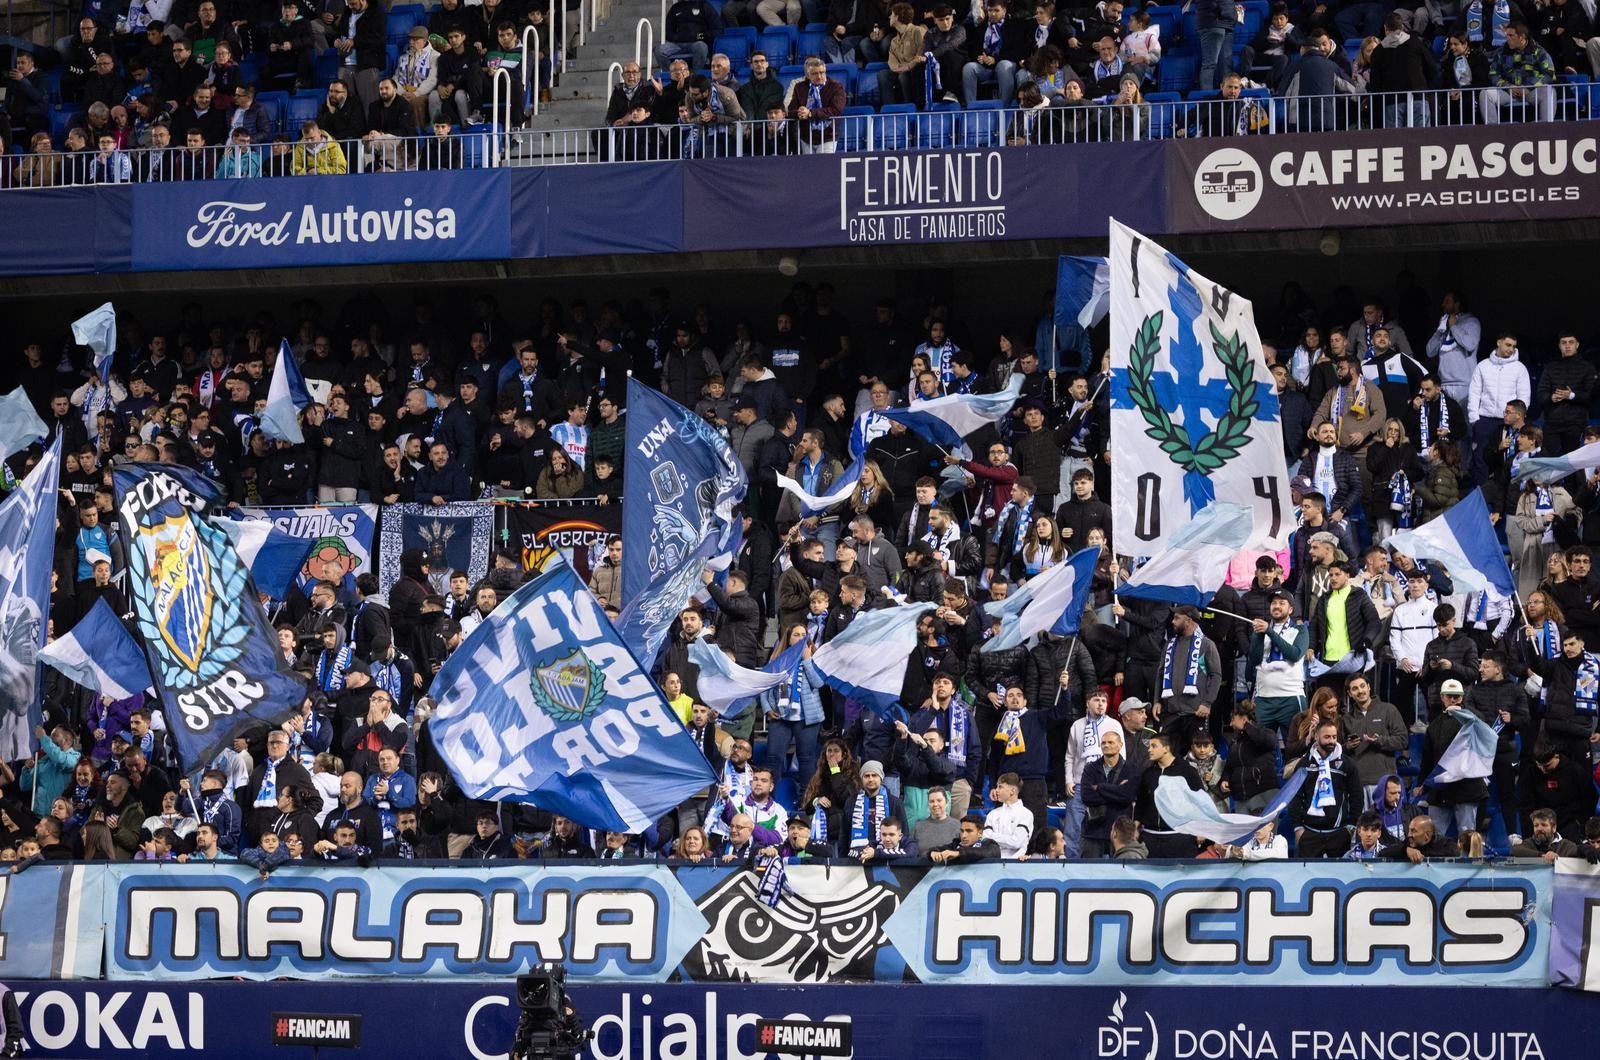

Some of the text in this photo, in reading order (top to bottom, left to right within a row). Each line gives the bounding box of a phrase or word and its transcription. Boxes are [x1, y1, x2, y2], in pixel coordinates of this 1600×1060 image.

[1270, 147, 1404, 188] CAFFE
[840, 151, 1003, 231] FERMENTO
[1202, 184, 1249, 194] PASCUCCI
[1331, 186, 1580, 211] WWW.PASCUCCI.ES
[186, 197, 456, 248] Ford Autovisa
[849, 212, 1006, 242] CASA DE PANADEROS
[637, 417, 676, 460] UNA
[243, 513, 358, 538] SUALS
[521, 531, 621, 549] EL PERCH
[176, 669, 264, 732] SUR
[126, 887, 656, 962] MALAKA
[931, 886, 1530, 966] HINCHAS
[275, 1016, 351, 1040] #FANCAM
[761, 1025, 841, 1048] #FANCAM
[1291, 1030, 1543, 1060] FRANCISQUITA
